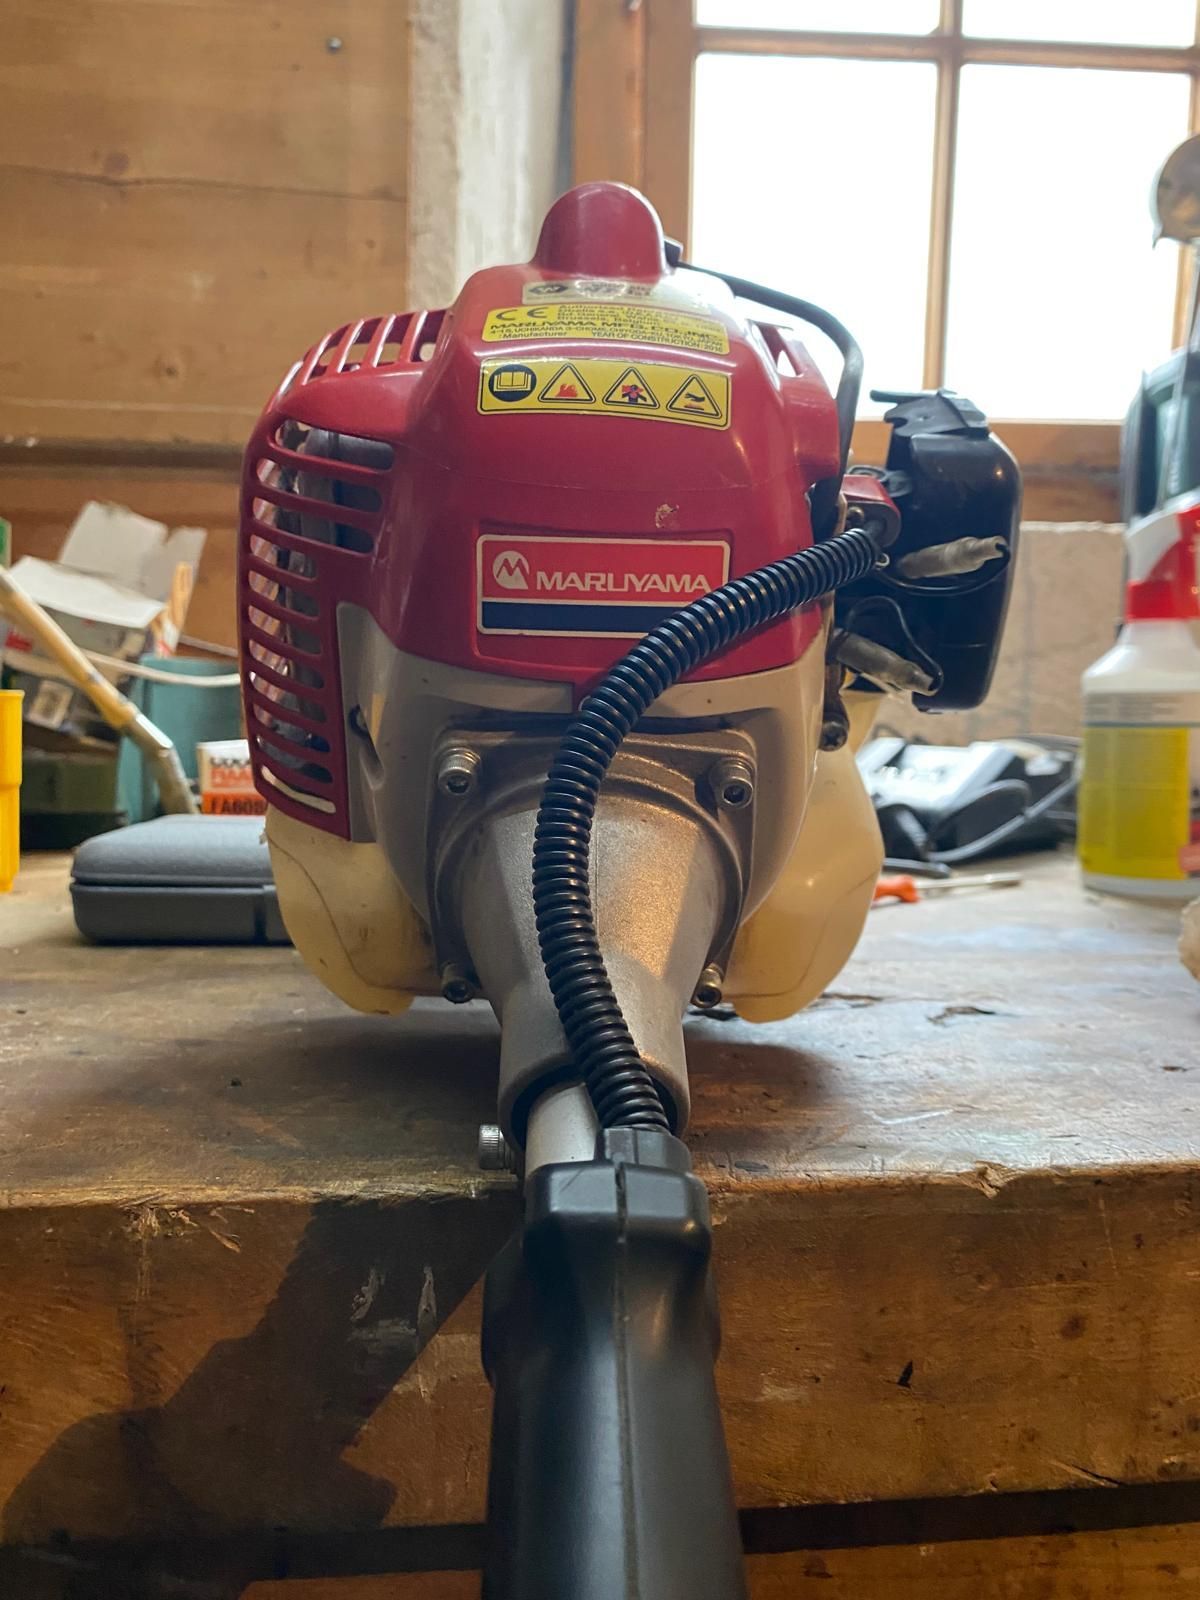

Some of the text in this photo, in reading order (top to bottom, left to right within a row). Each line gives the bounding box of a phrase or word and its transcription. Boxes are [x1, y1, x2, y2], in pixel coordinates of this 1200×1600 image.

[496, 307, 548, 320] CE
[490, 320, 596, 330] MARUYAMA
[535, 571, 713, 593] MARUYAMA
